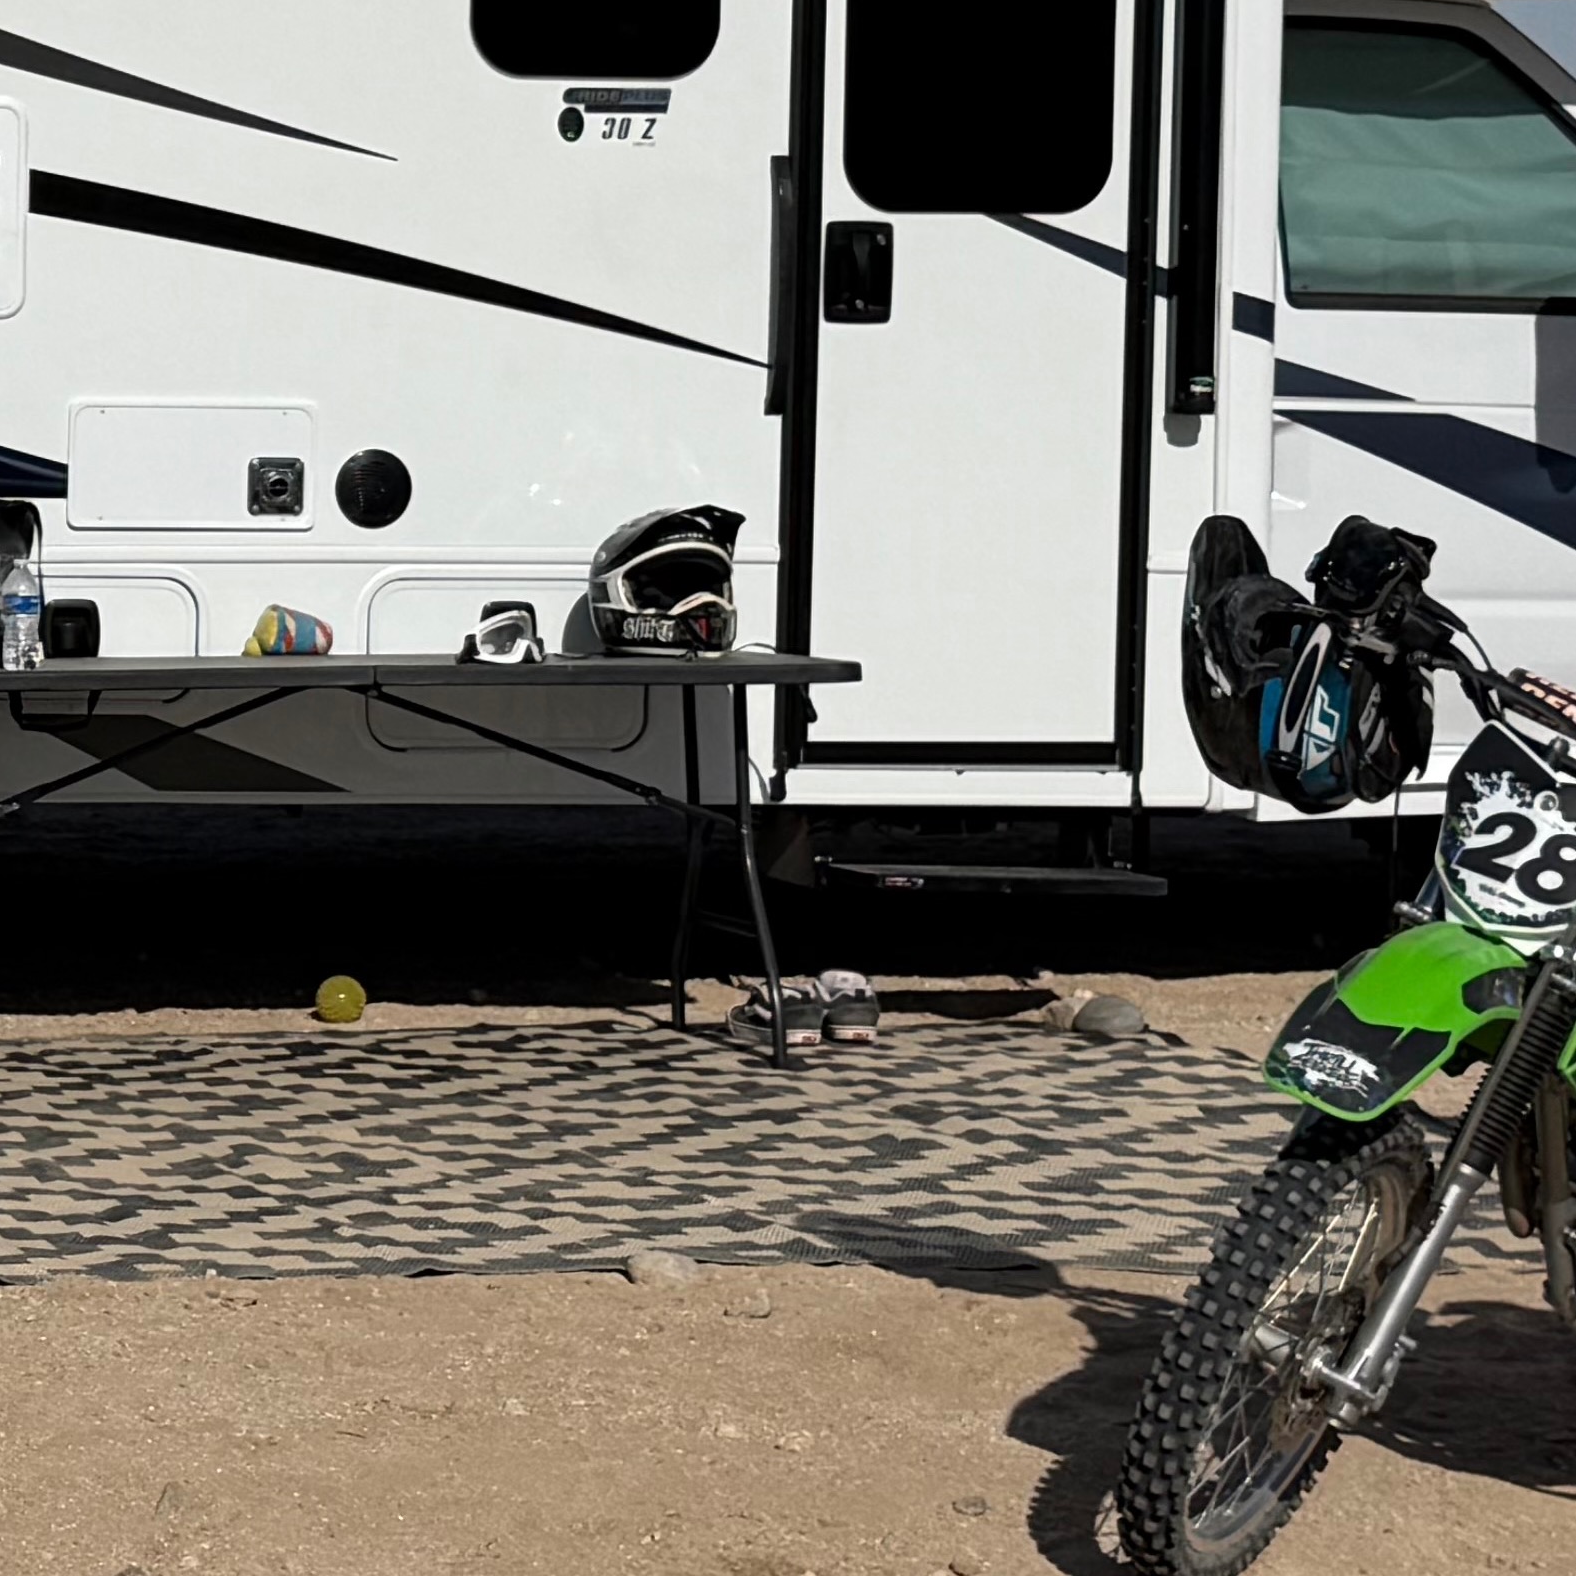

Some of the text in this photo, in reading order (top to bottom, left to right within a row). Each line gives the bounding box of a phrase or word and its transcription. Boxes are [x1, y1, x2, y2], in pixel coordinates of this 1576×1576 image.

[601, 117, 657, 140] 30 Z
[1452, 811, 1576, 906] 28
